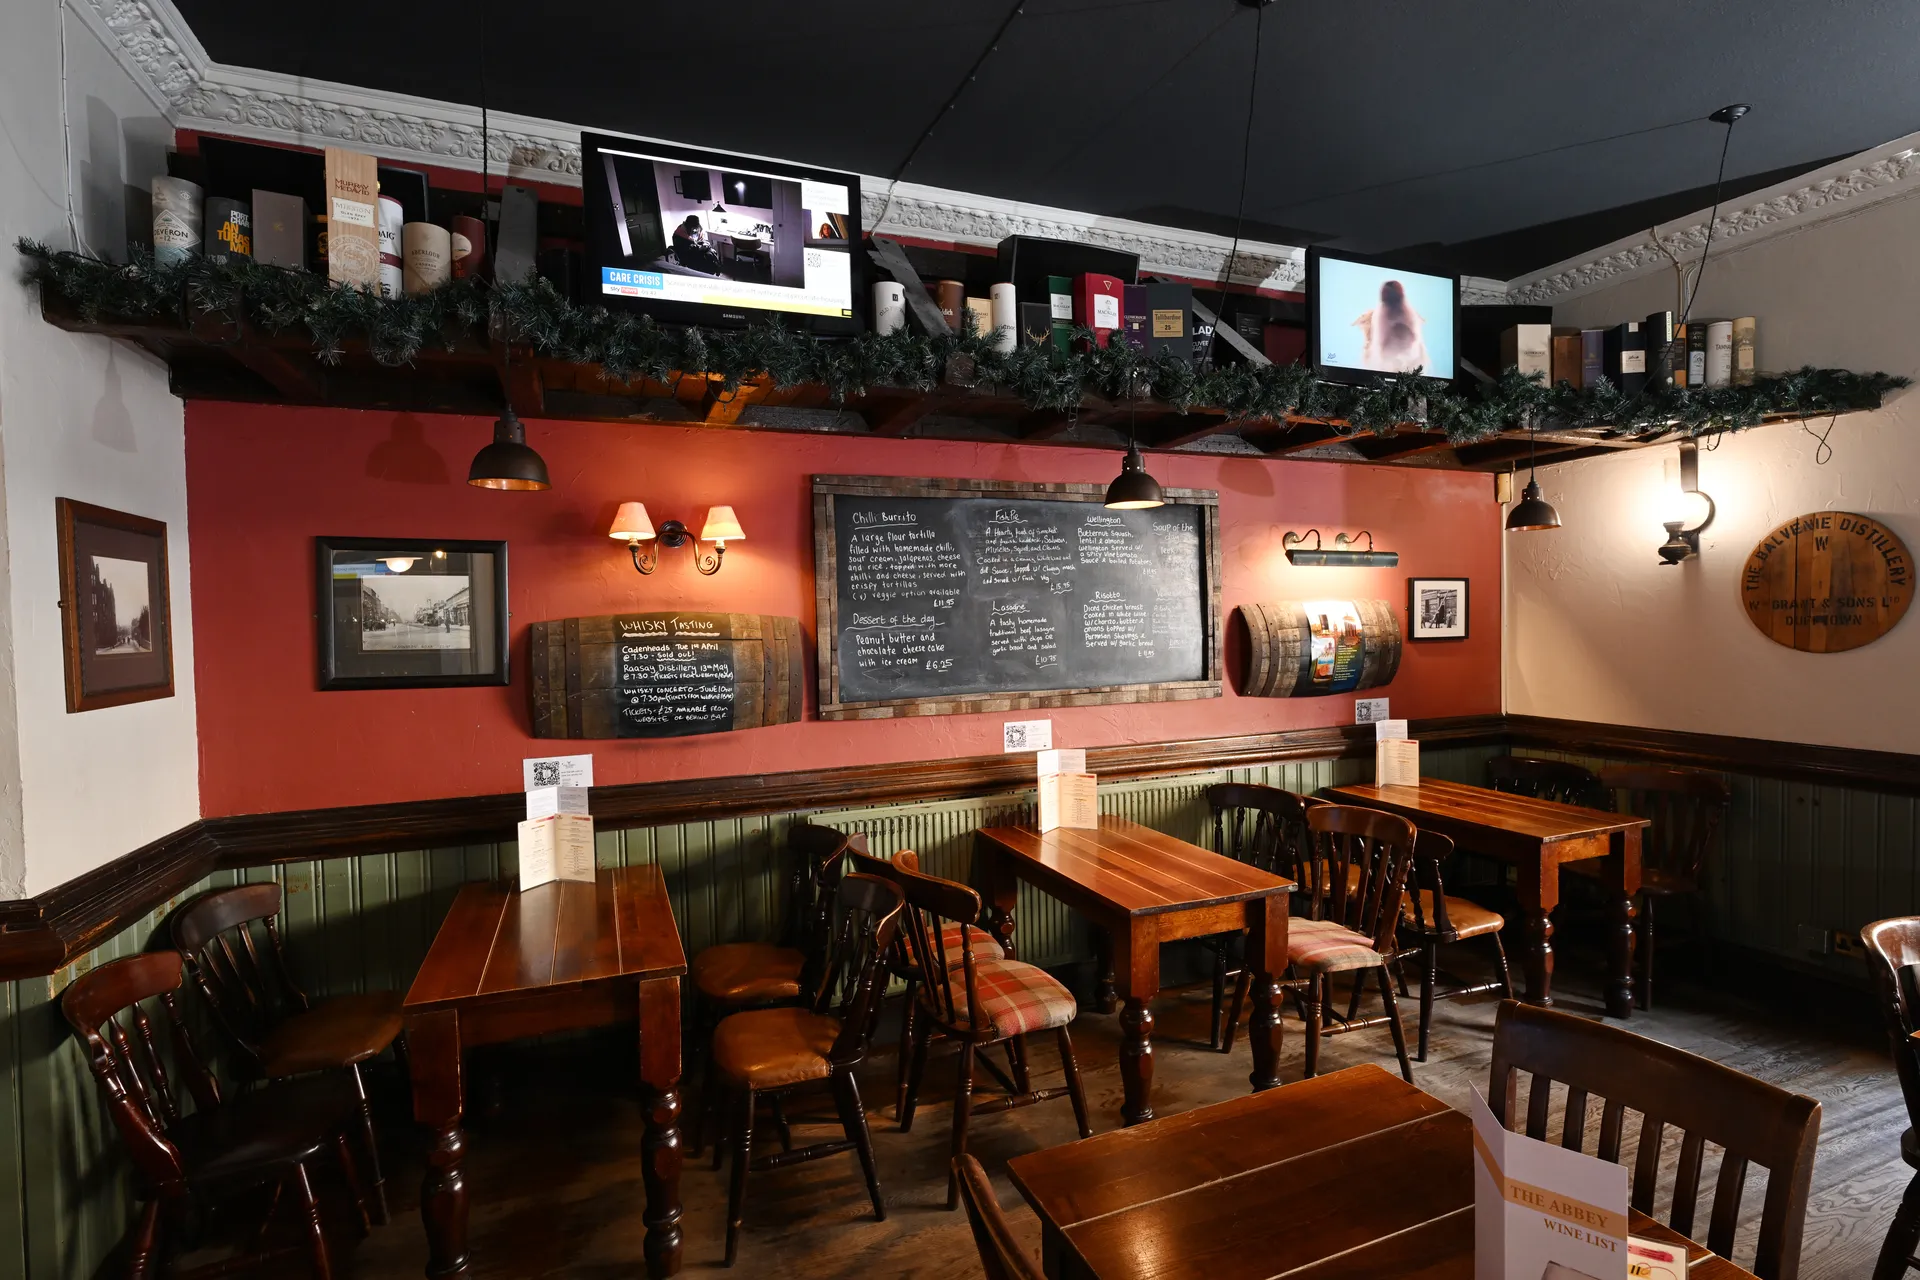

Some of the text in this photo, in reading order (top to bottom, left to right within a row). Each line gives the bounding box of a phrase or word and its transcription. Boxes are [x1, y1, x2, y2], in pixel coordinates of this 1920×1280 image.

[335, 179, 369, 190] MURRAY
[231, 210, 248, 221] PORT
[223, 221, 239, 234] AN
[610, 271, 660, 286] CARE CRISIS
[853, 511, 916, 524] Chilli Burrito
[1087, 515, 1121, 527] Wellington
[985, 527, 990, 537] A
[1078, 528, 1109, 537] Butternut
[1182, 523, 1193, 532] the
[862, 534, 884, 546] large
[888, 532, 906, 542] flour
[909, 530, 935, 539] tortilla
[850, 544, 869, 554] filled
[873, 545, 891, 553] with
[894, 544, 933, 552] homemade
[1746, 517, 1906, 591] THE BALVENIE DISTILLERY
[849, 555, 865, 563] sour
[848, 564, 862, 572] and
[890, 563, 915, 571] topped
[850, 573, 871, 581] chilli
[923, 571, 946, 579] served
[851, 581, 917, 590] crispy tortillas
[873, 592, 897, 601] veggie
[901, 590, 926, 598] option
[1095, 591, 1120, 600] Risotto
[993, 600, 1026, 613] Lasagne
[1772, 599, 1816, 610] GRANT
[1821, 599, 1830, 609] &
[1838, 596, 1875, 609] SONS
[1084, 605, 1100, 613] Diced
[620, 620, 666, 631] WHISKY
[853, 613, 935, 630] Dessert of the day
[1000, 618, 1015, 629] tasty
[1035, 626, 1055, 634] lasagne
[856, 633, 935, 645] Peanut butter and
[622, 644, 670, 654] Cadenheads
[857, 645, 896, 656] chocolate
[859, 659, 875, 667] with
[882, 658, 891, 666] ice
[624, 664, 729, 676] Raasay Distillery May
[1510, 1185, 1608, 1228] THE ABBEY
[1543, 1218, 1618, 1252] WINE LIST
